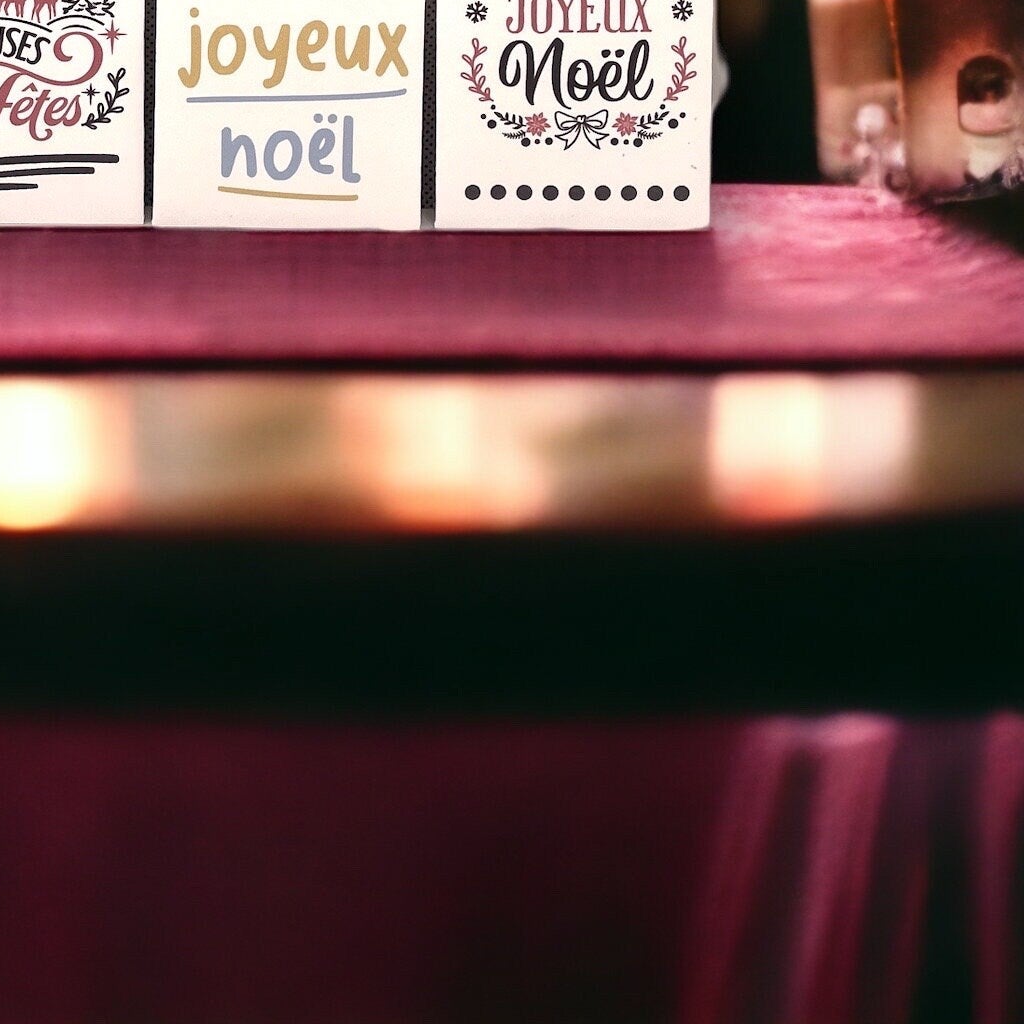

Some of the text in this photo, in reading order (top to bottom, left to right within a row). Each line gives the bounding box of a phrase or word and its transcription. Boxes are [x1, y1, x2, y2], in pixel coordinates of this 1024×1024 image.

[177, 7, 409, 89] joyeux
[498, 36, 655, 110] Noël
[220, 113, 361, 184] noël
